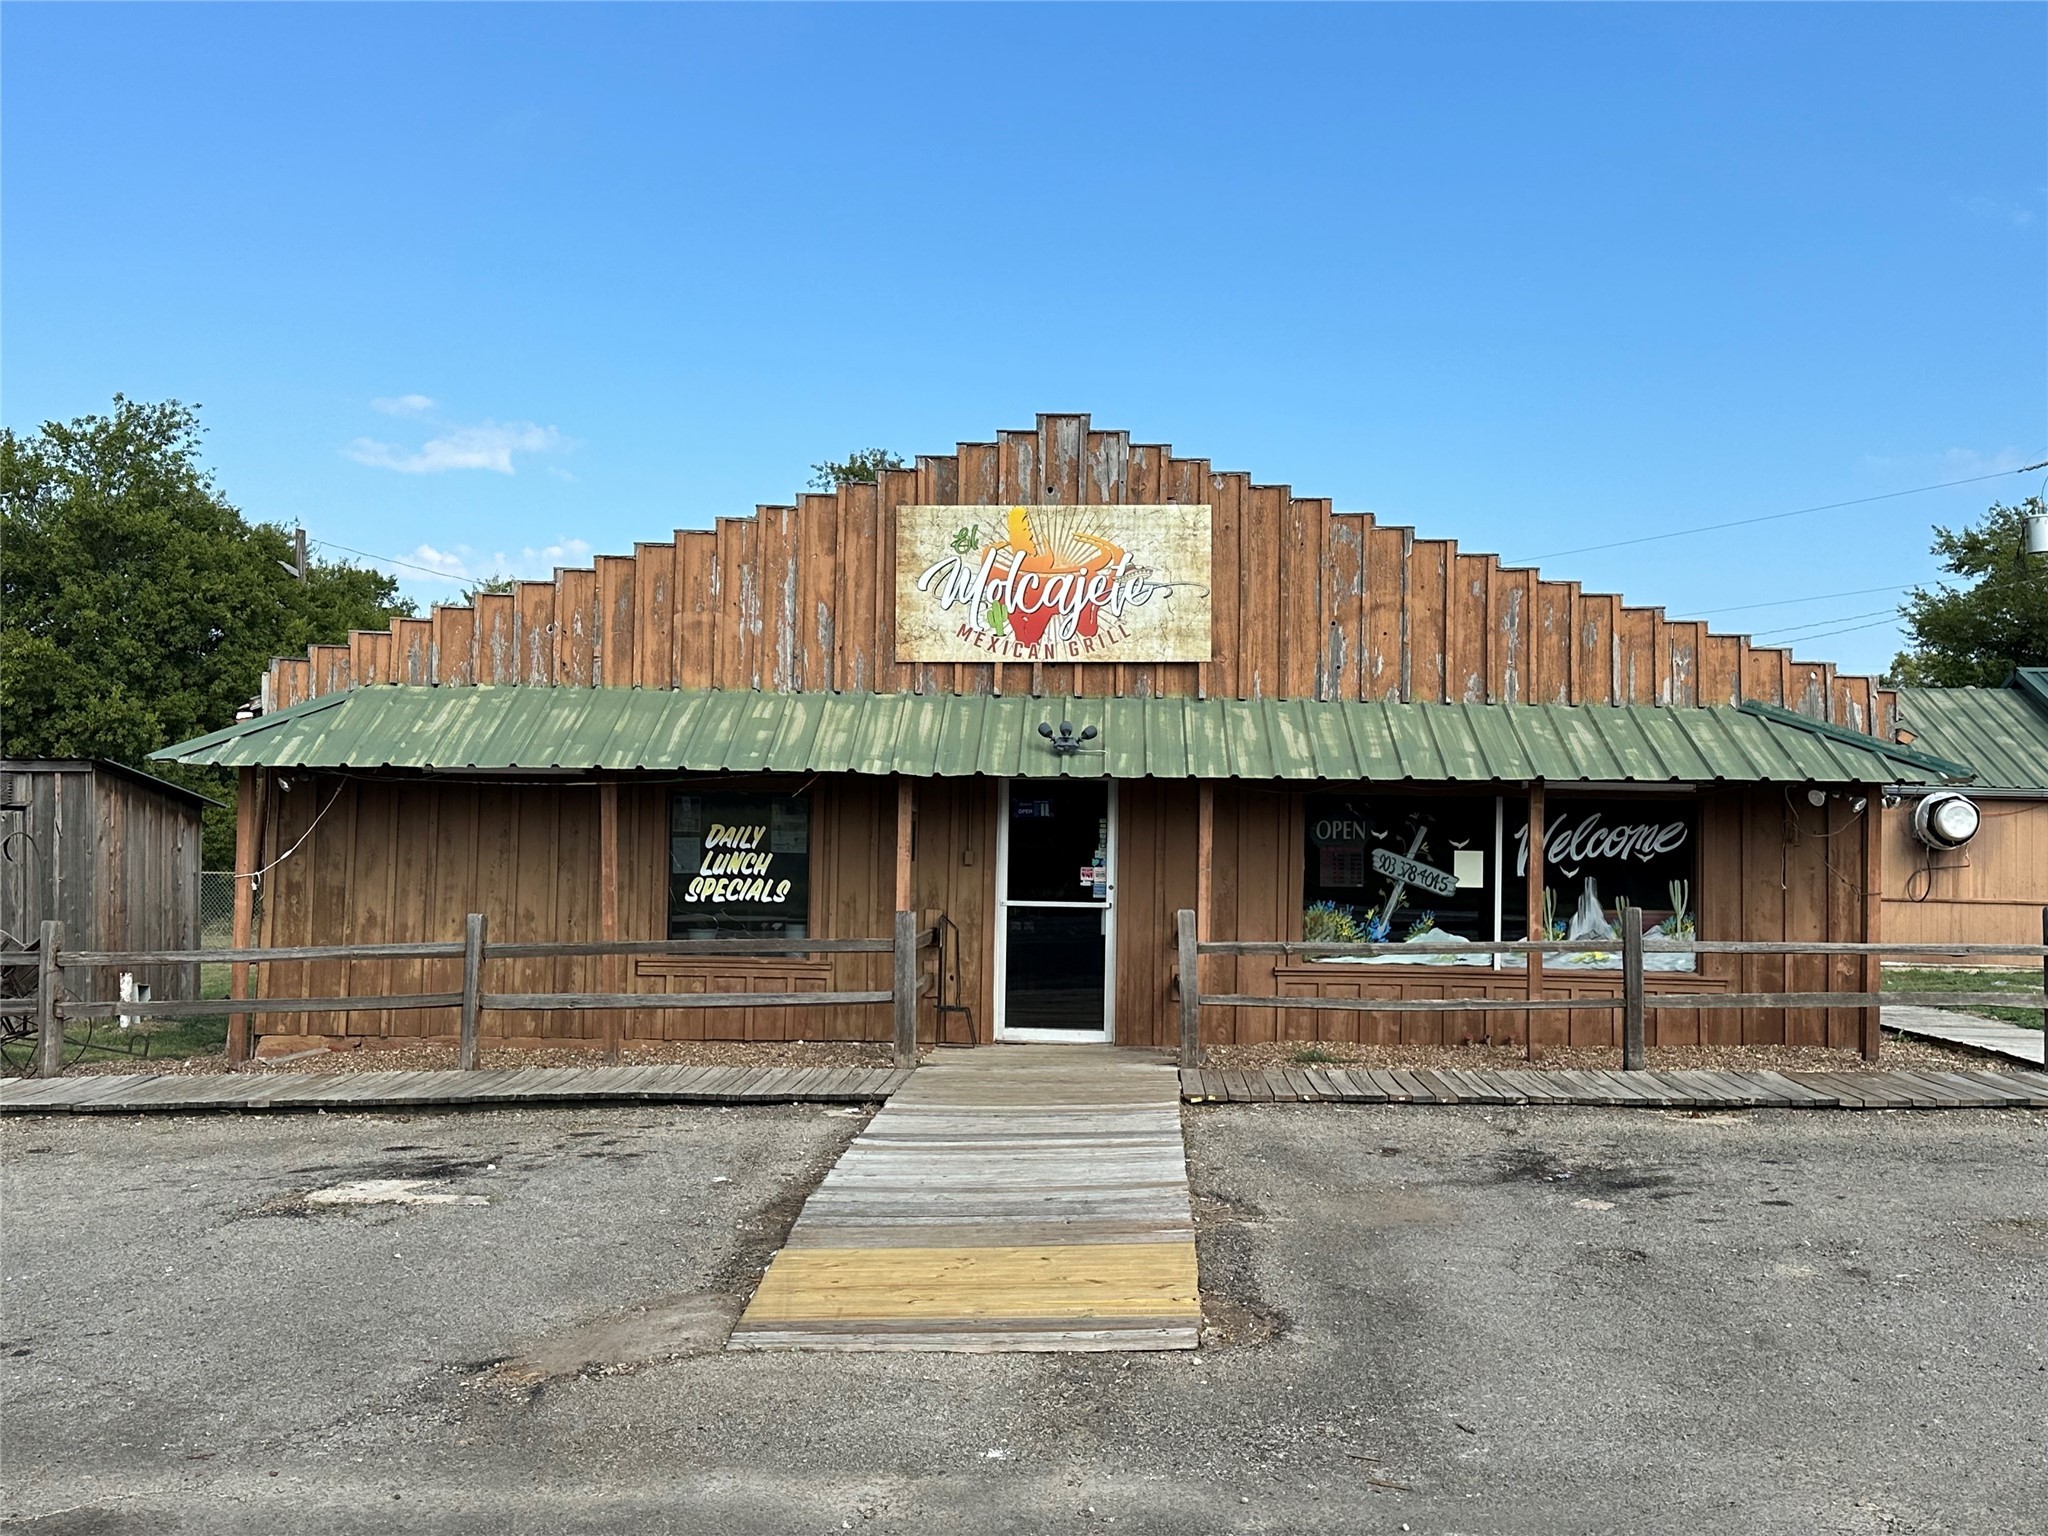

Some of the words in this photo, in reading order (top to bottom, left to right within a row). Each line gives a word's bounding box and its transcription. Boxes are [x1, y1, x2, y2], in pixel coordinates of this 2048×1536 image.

[950, 524, 979, 555] El
[917, 547, 1175, 641] Molcajete
[955, 623, 1055, 660] MEXICAN
[1069, 624, 1132, 657] GRILL
[705, 823, 767, 850] DAILY
[1314, 819, 1366, 840] OPEN
[1514, 813, 1688, 877] Welcome
[699, 850, 773, 877] LUNCH
[1379, 853, 1397, 875] 903
[684, 876, 791, 903] SPECIALS
